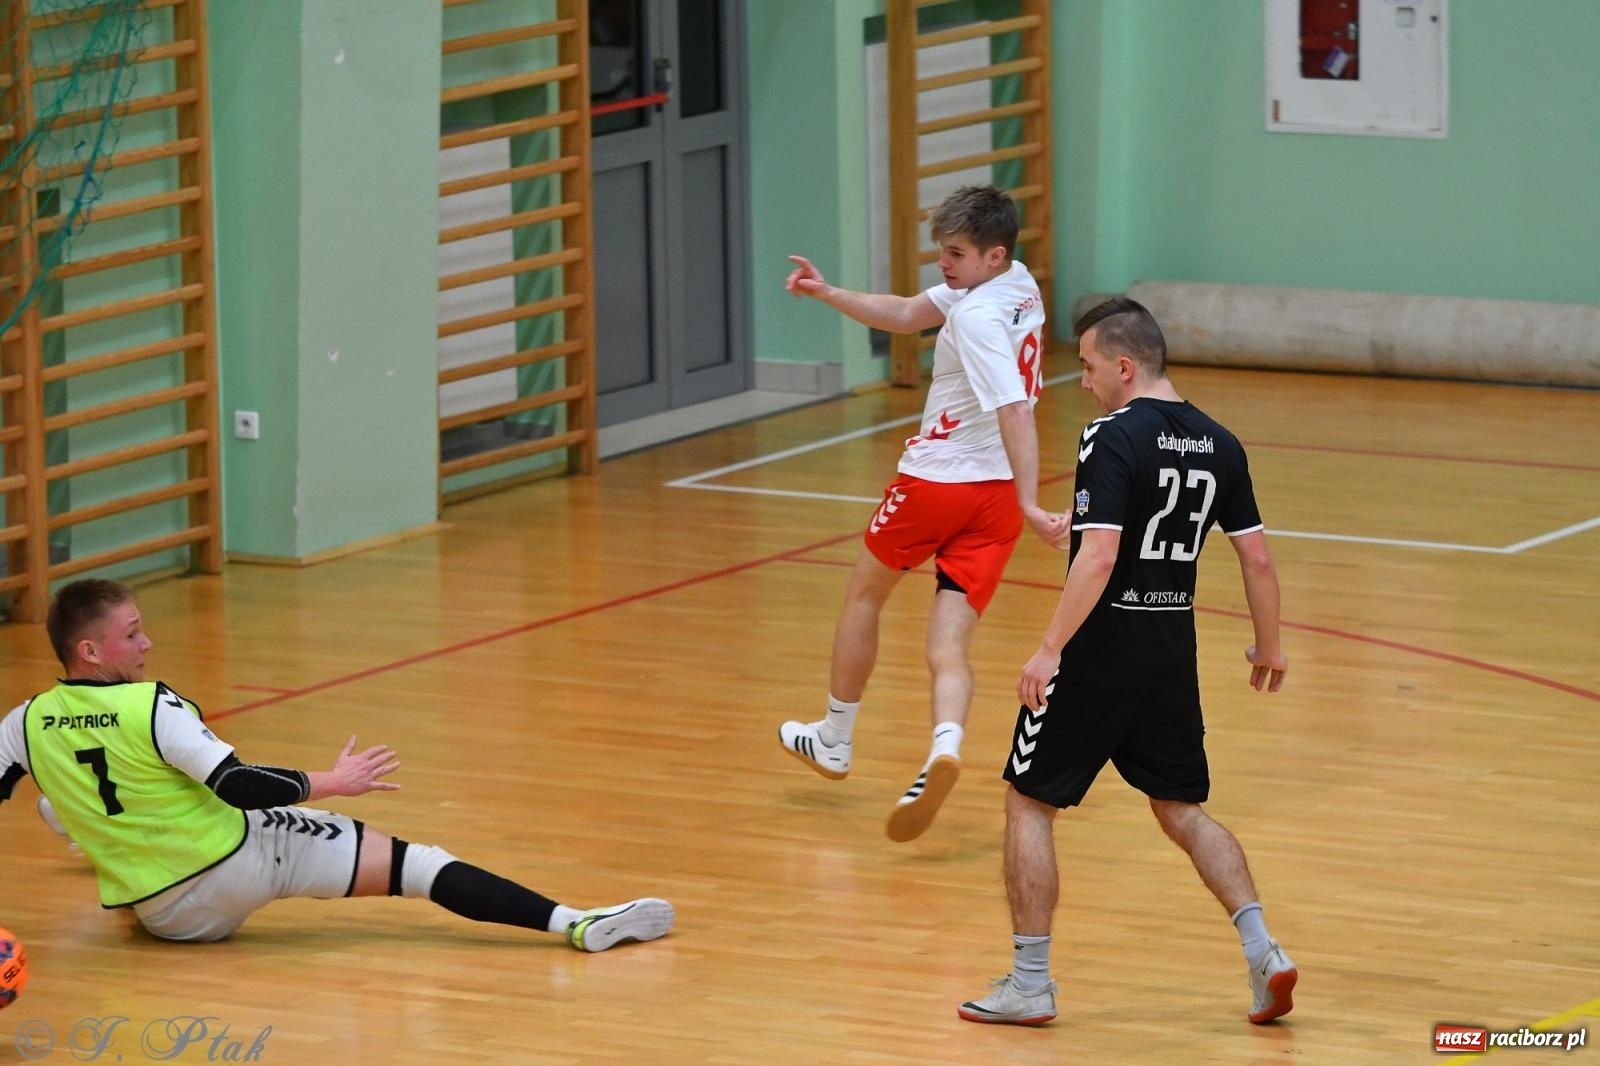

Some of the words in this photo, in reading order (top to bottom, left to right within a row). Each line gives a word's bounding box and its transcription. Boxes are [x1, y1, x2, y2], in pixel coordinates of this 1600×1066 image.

[1139, 467, 1217, 561] 23
[1143, 591, 1187, 604] OFISTAR
[58, 713, 120, 729] PATRICK
[74, 746, 125, 817] 7
